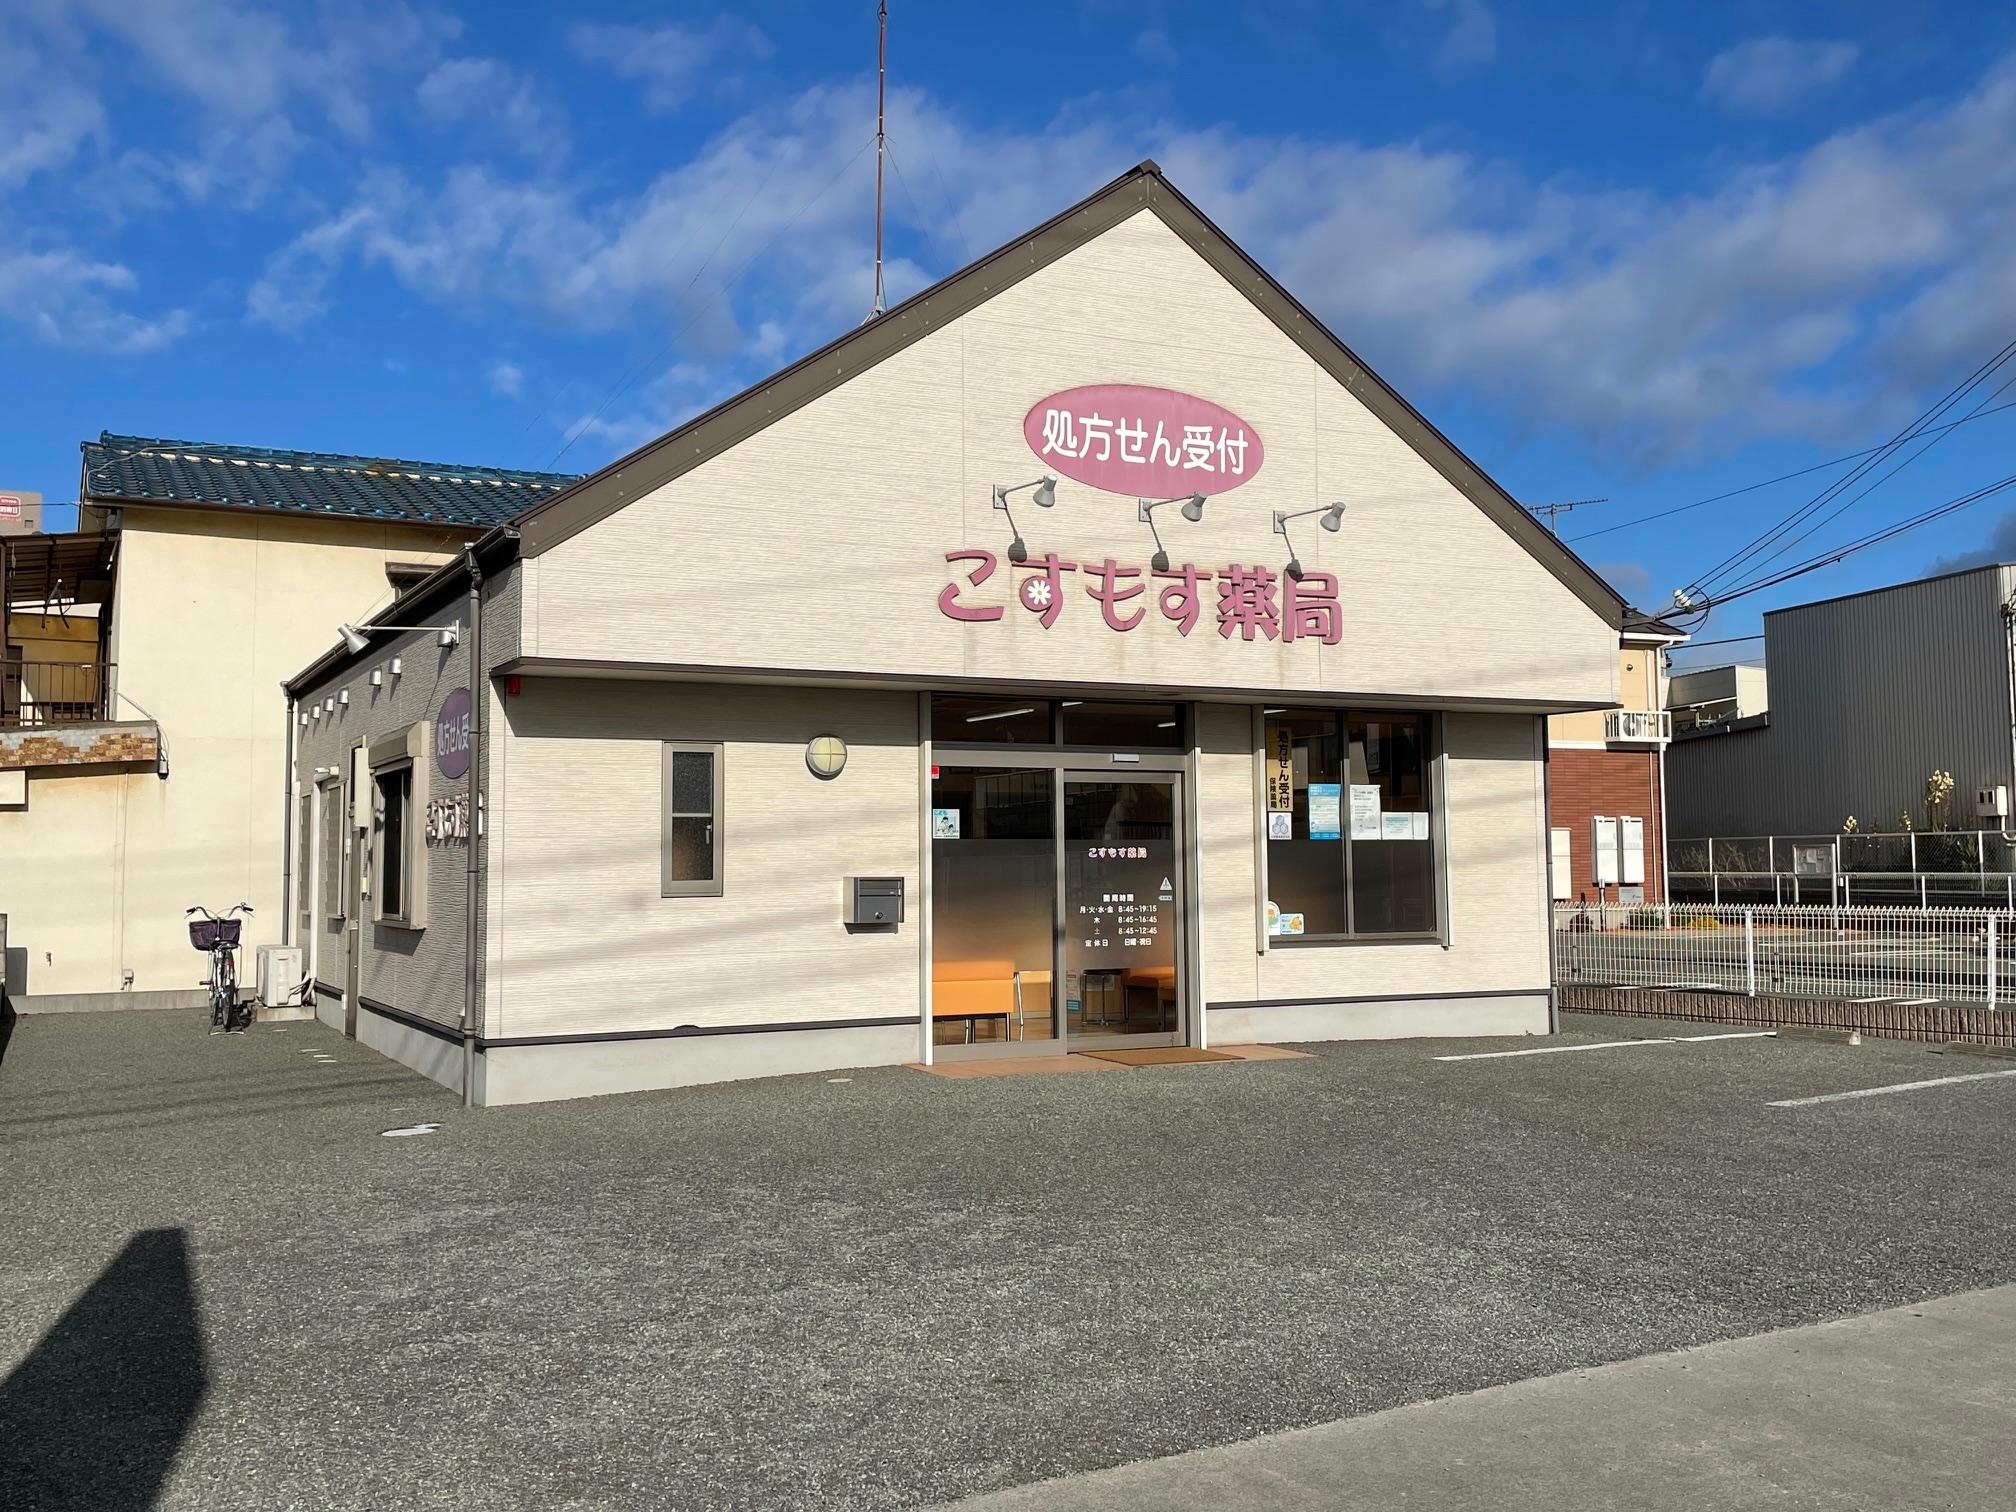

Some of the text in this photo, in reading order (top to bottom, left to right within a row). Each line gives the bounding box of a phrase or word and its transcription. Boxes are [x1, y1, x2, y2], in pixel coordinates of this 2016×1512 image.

[1042, 408, 1249, 475] 処方せん受付
[939, 549, 1343, 645] こすもす薬局
[437, 712, 469, 757] 処方せん受
[1278, 731, 1290, 808] 処方せん受付
[1088, 847, 1147, 858] こすもす薬局
